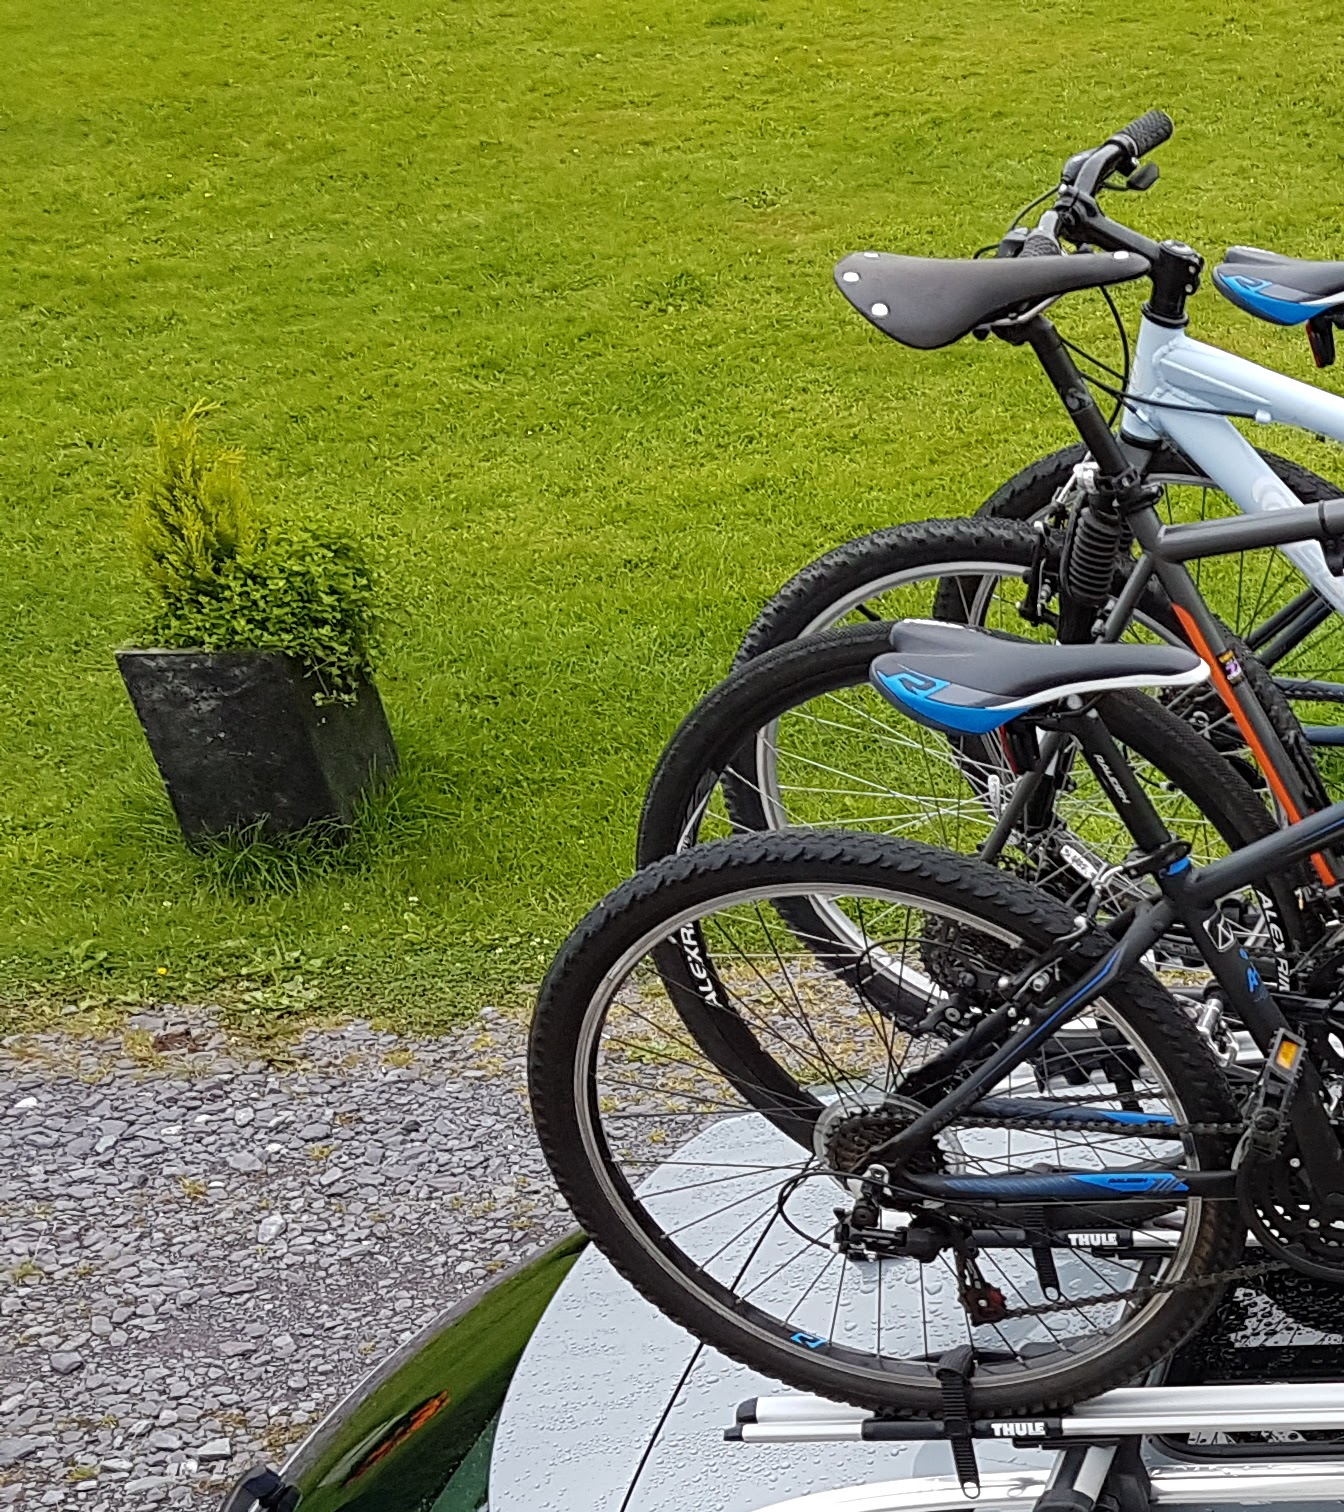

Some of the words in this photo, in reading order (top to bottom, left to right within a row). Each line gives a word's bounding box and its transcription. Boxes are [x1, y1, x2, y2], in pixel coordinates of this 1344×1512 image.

[1093, 753, 1131, 804] RALEIGH
[1067, 1233, 1118, 1247] THULE
[991, 1422, 1046, 1437] THULE
